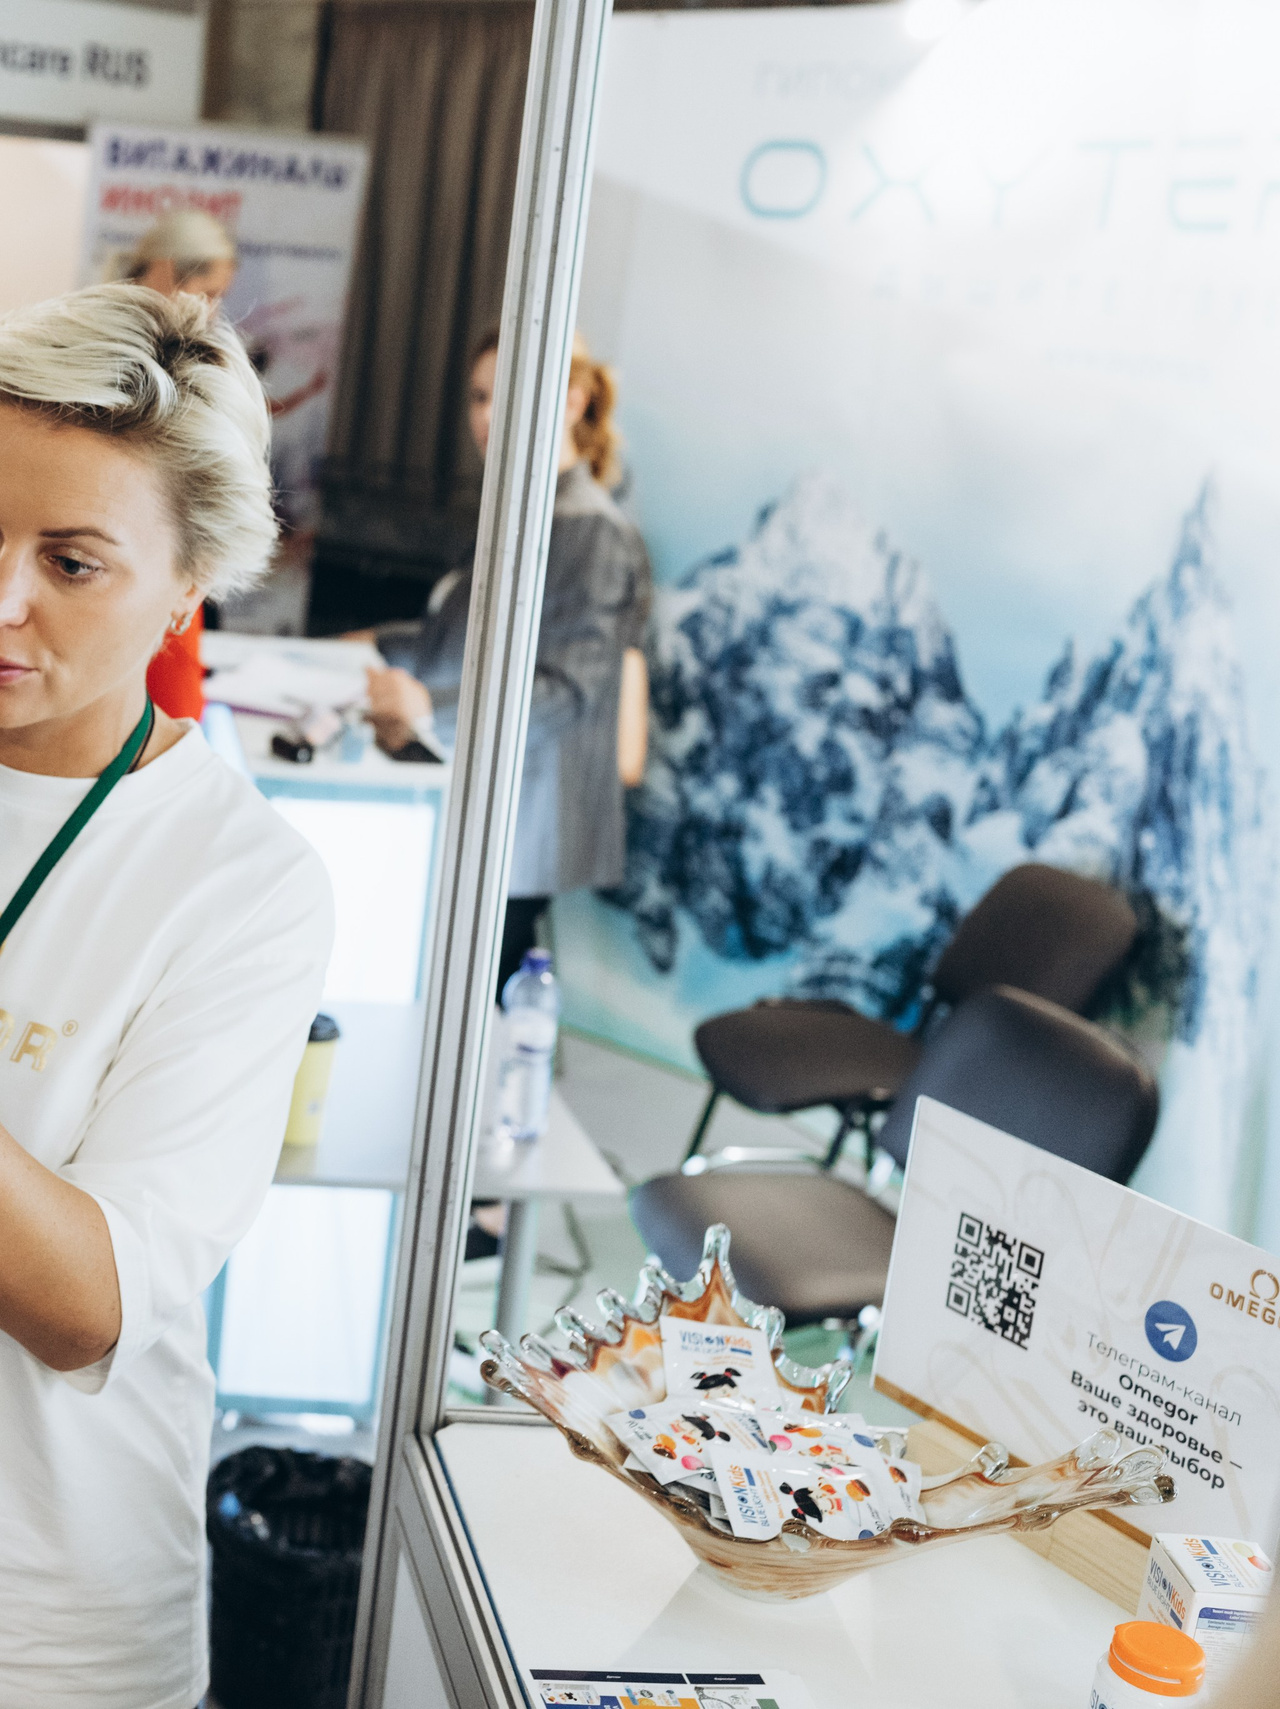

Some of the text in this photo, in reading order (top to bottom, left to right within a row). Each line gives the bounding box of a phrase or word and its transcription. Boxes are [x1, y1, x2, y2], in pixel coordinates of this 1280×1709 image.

[83, 43, 151, 88] RUS
[739, 137, 1280, 233] OXYTE
[1209, 1282, 1280, 1330] OMEG
[1087, 1331, 1242, 1426] Телеграм-канал
[1119, 1373, 1198, 1426] Omegor
[1070, 1370, 1122, 1409] Ваше
[1126, 1403, 1223, 1464] здоровье
[1077, 1399, 1109, 1425] это
